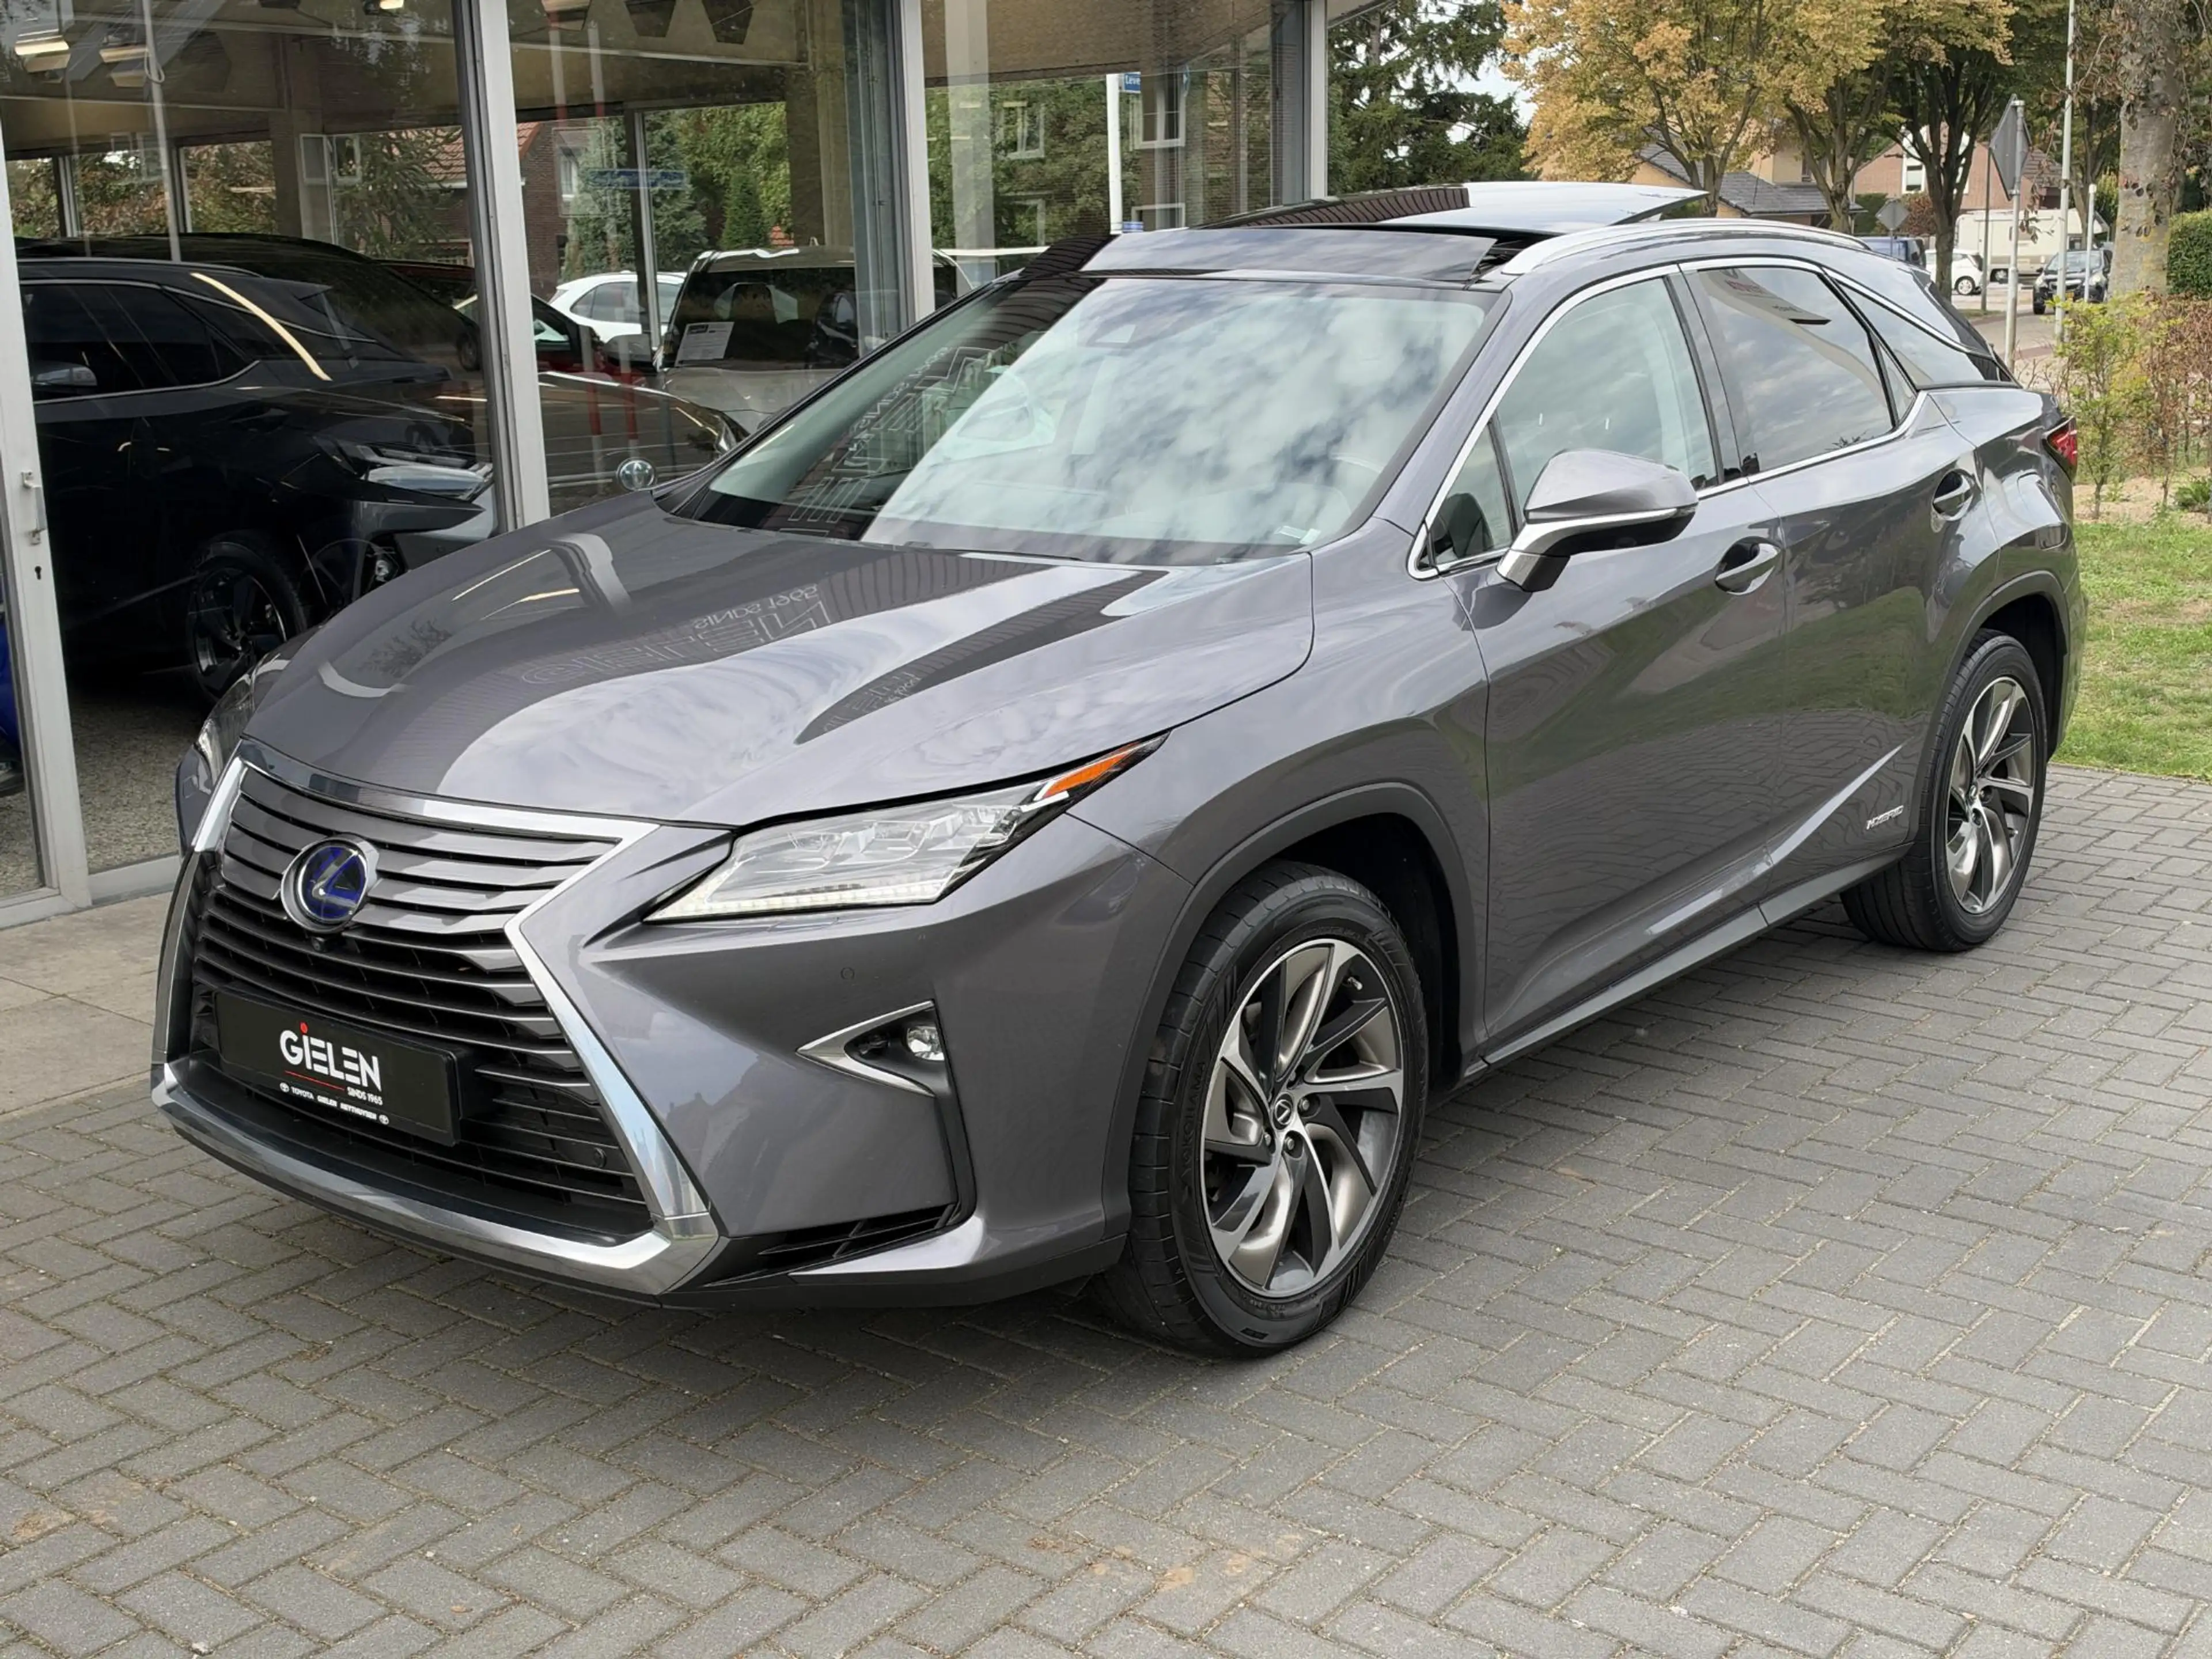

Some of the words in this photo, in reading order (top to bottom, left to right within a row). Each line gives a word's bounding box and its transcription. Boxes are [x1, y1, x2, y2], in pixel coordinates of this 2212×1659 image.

[291, 1086, 314, 1100] TOYOTA
[347, 1086, 367, 1101] SINDS
[367, 1092, 383, 1106] 1965
